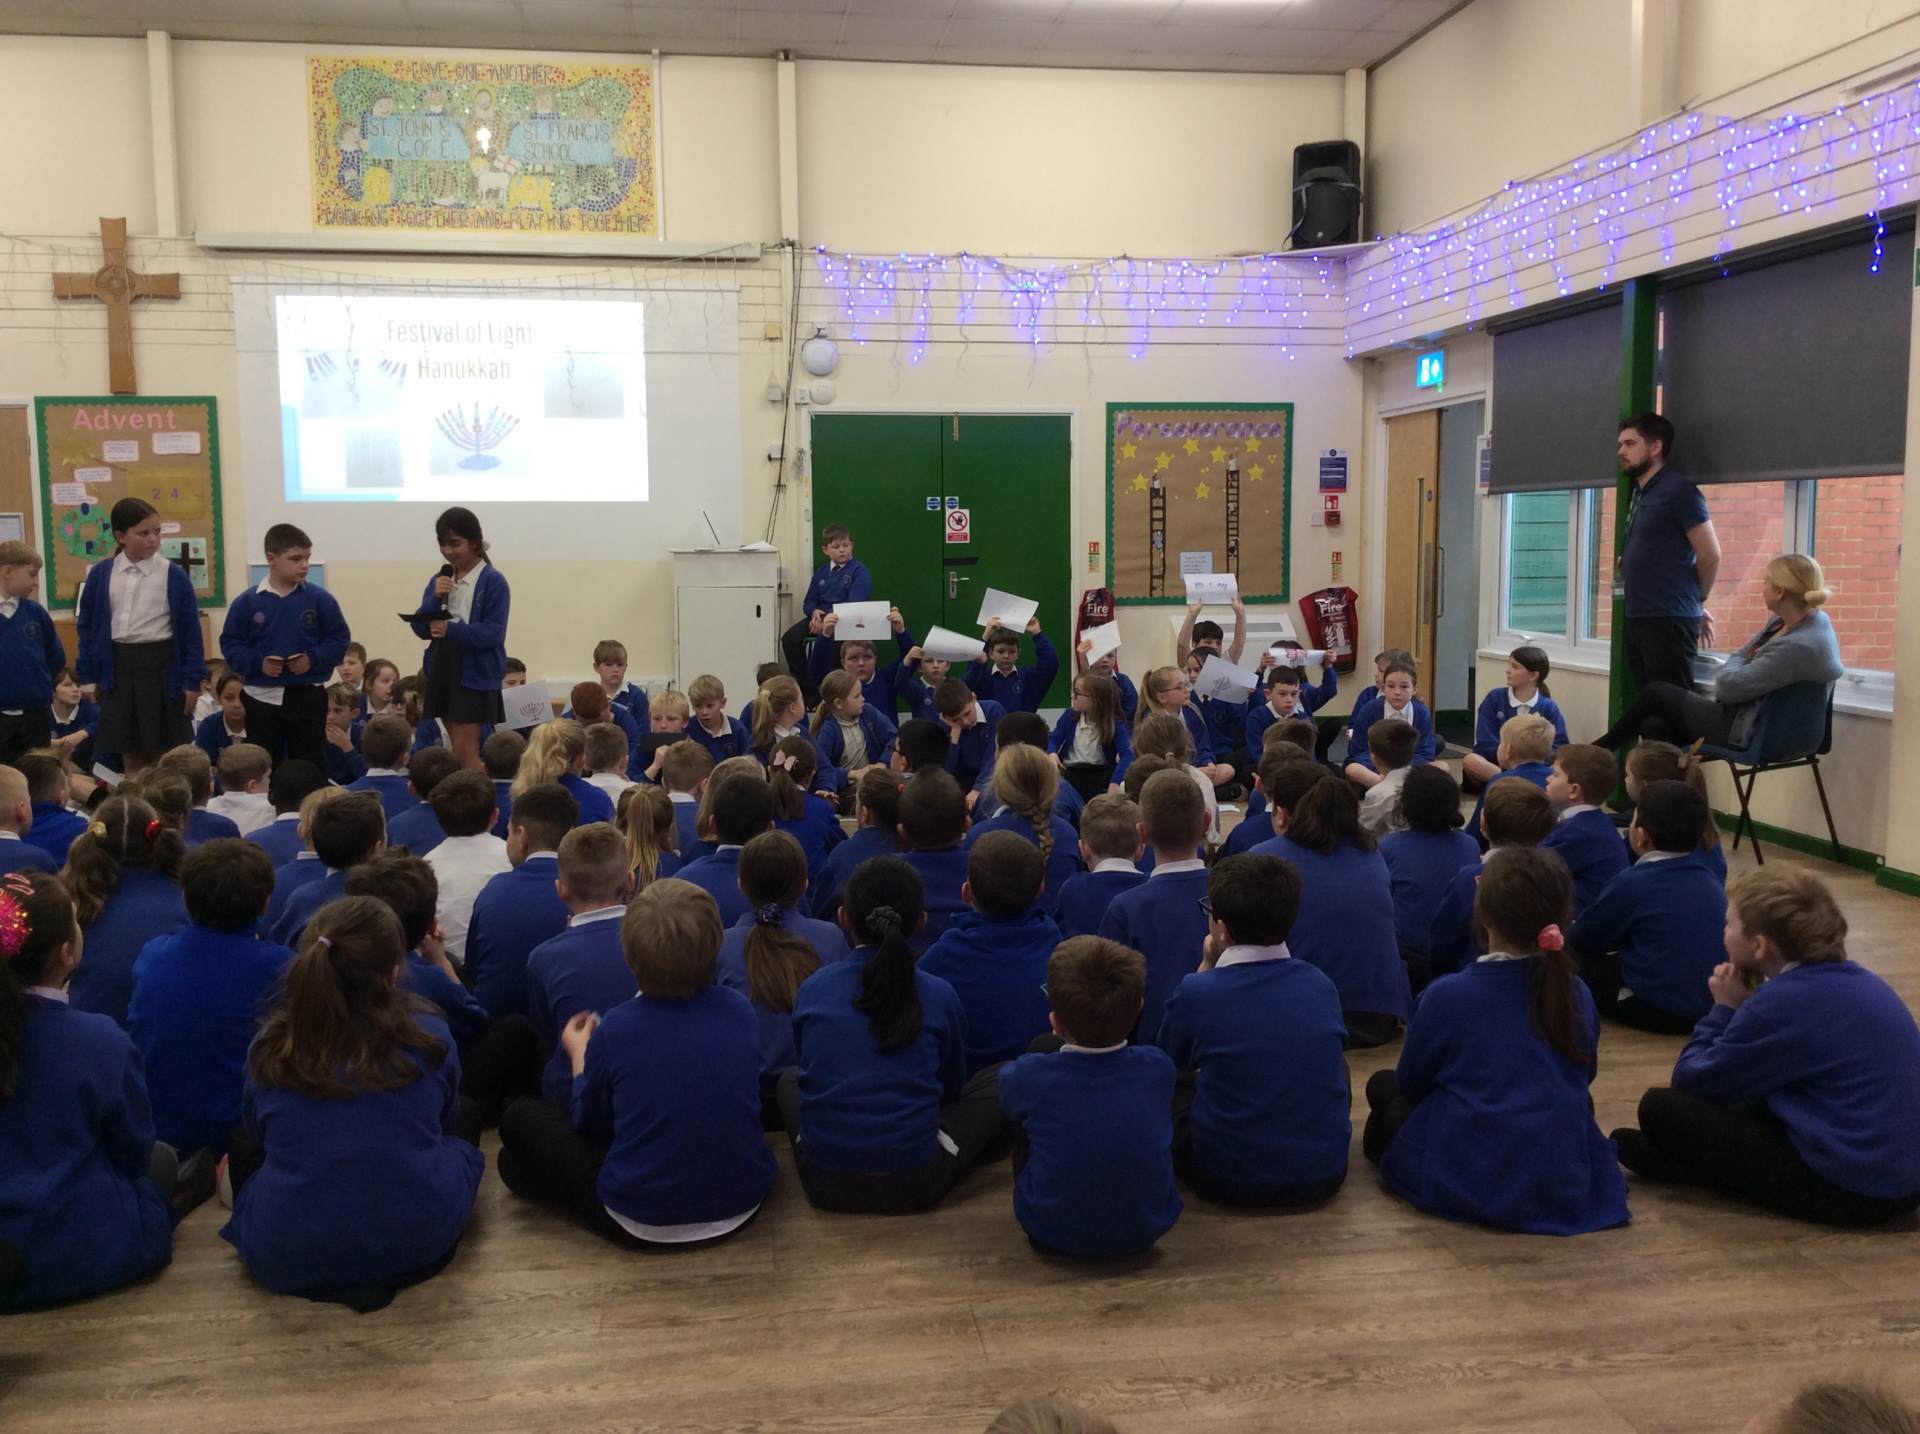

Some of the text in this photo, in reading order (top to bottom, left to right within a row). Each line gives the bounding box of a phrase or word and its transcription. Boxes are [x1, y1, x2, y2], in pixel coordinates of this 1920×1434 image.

[412, 61, 551, 83] LOVE ONE ANOTHER
[397, 119, 432, 137] JOHN
[549, 121, 610, 142] FRANCIS
[524, 142, 576, 160] SCHOOL
[579, 211, 647, 233] TOGETHER
[387, 319, 533, 349] Festival of Light
[418, 356, 511, 380] Hanukkah
[73, 408, 177, 430] Advent
[1117, 412, 1281, 438] Perseverance
[1087, 602, 1109, 614] Fire
[1320, 601, 1344, 615] Fire
